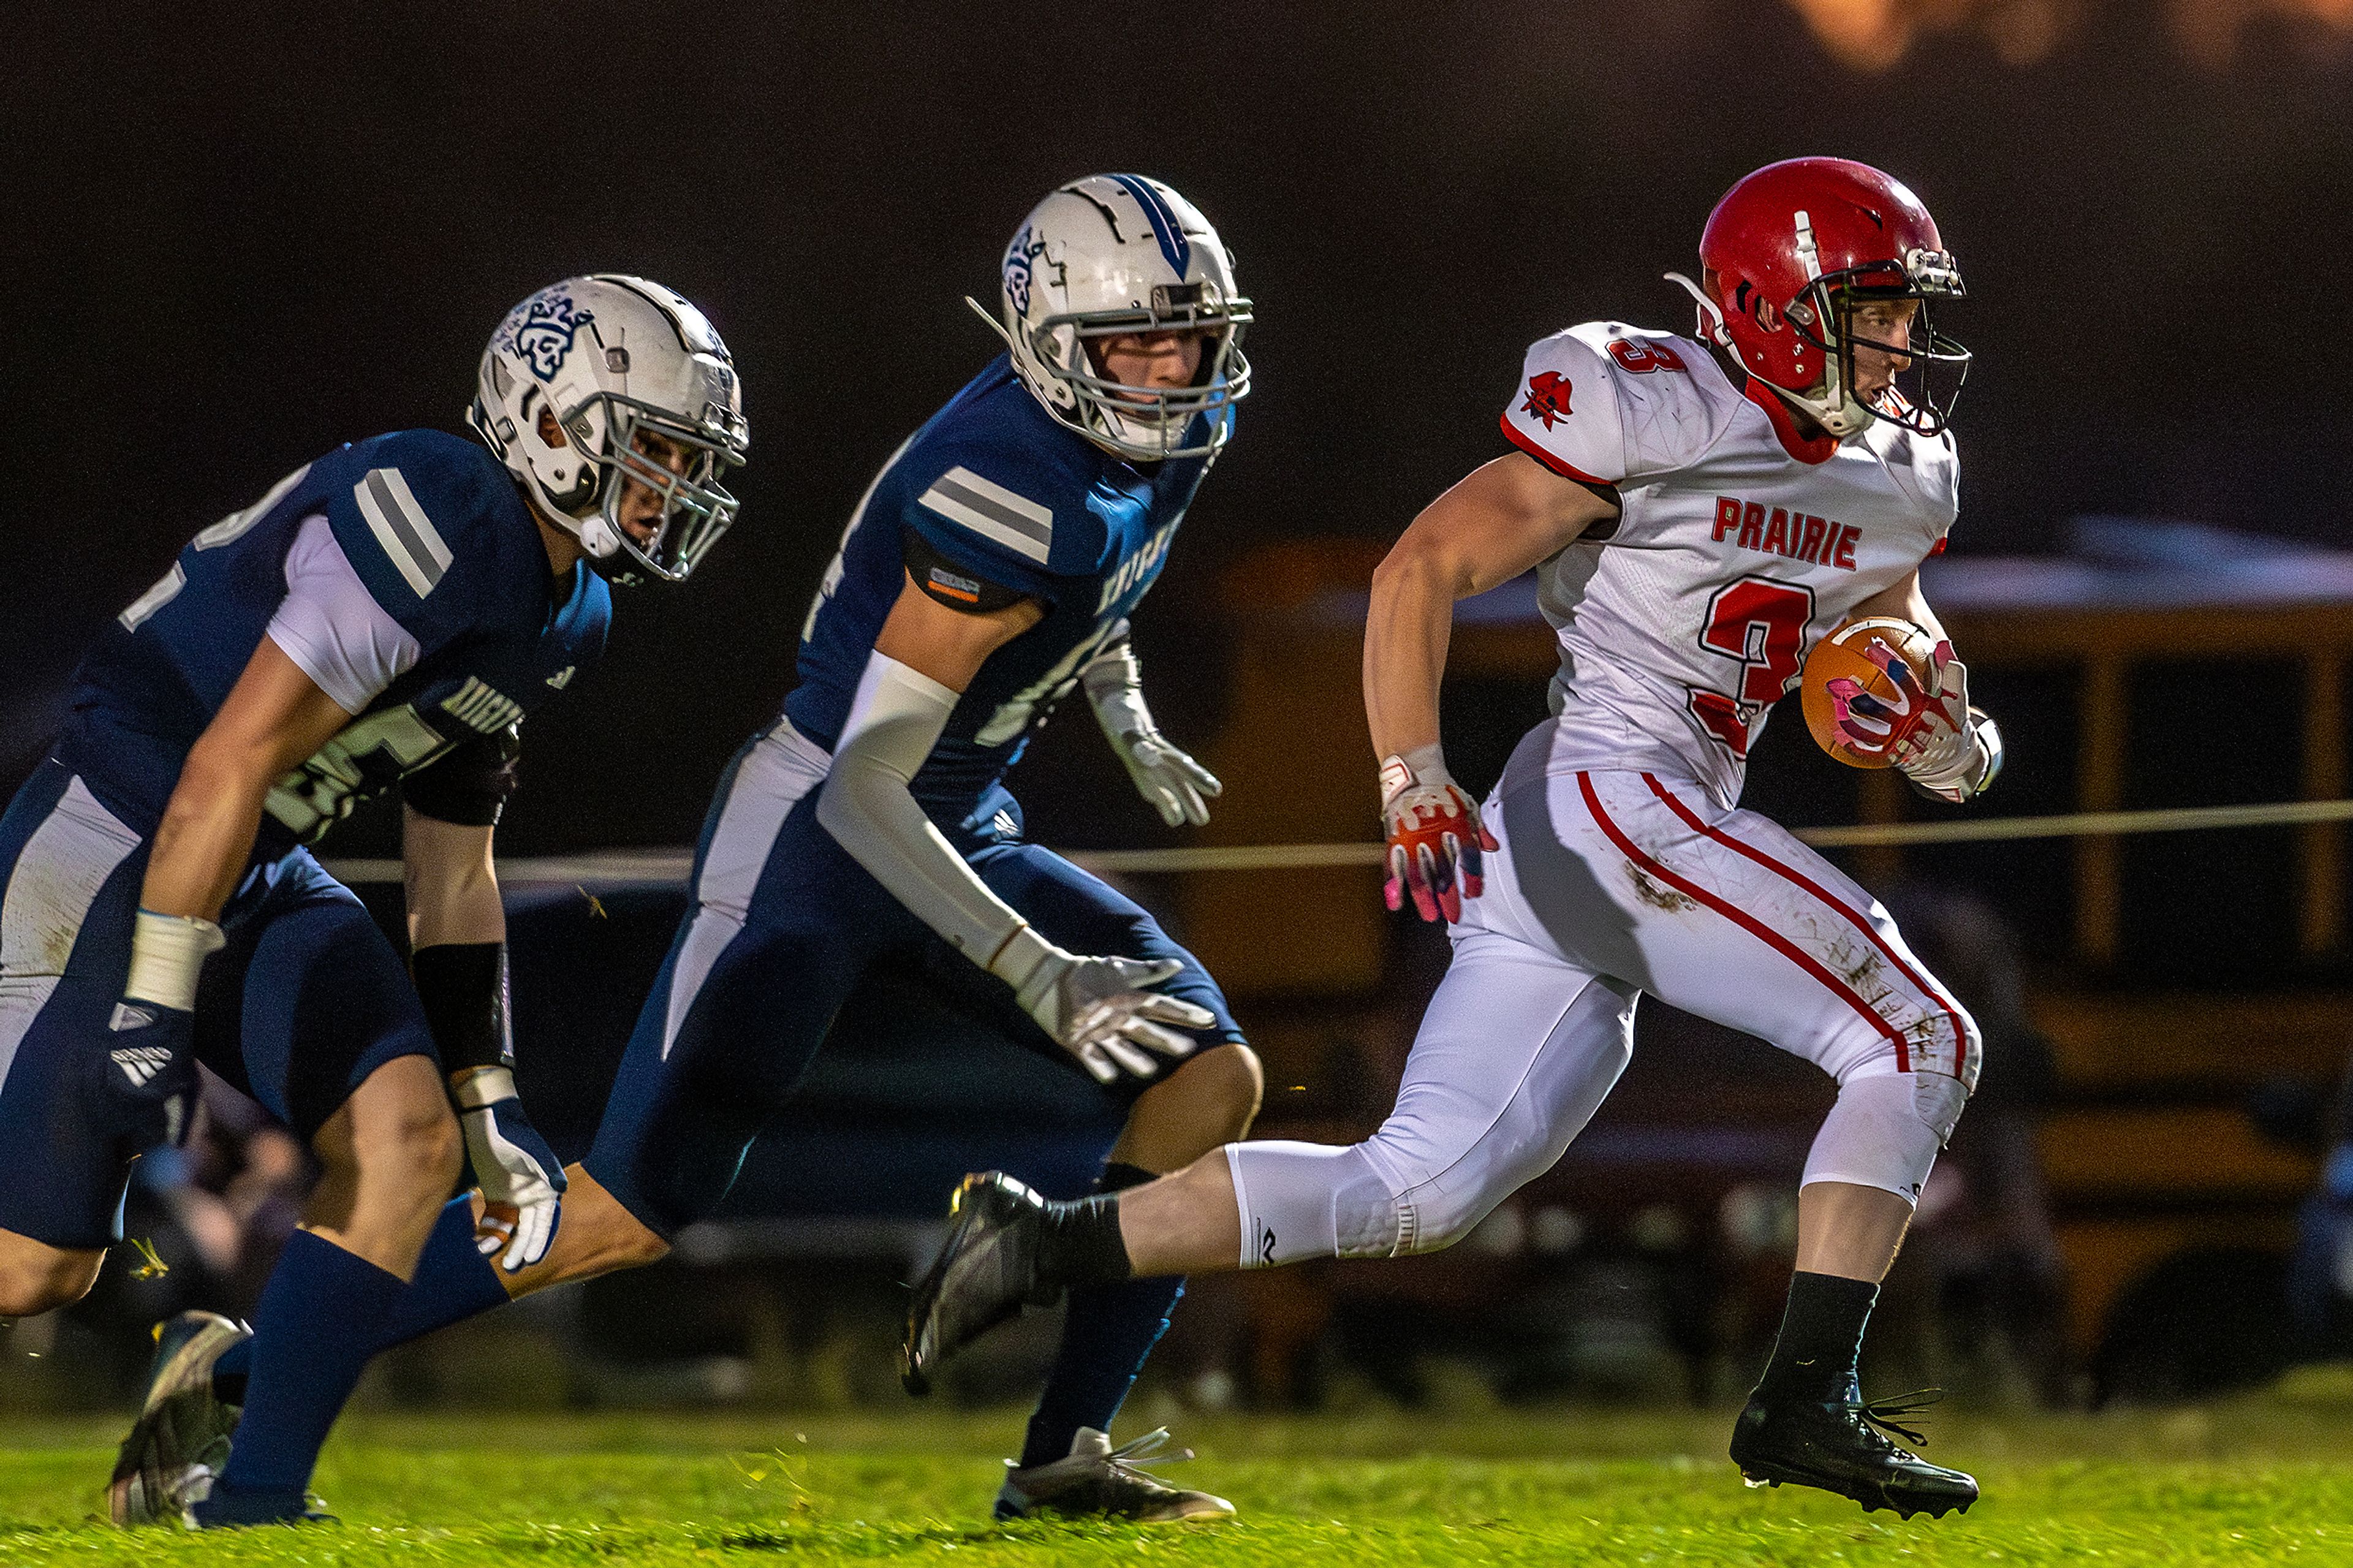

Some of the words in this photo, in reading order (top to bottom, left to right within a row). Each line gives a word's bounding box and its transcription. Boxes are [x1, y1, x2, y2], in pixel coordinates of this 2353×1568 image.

[1605, 338, 1688, 374] 3
[1711, 496, 1863, 571] PRAIRIE
[1687, 574, 1816, 762] 3
